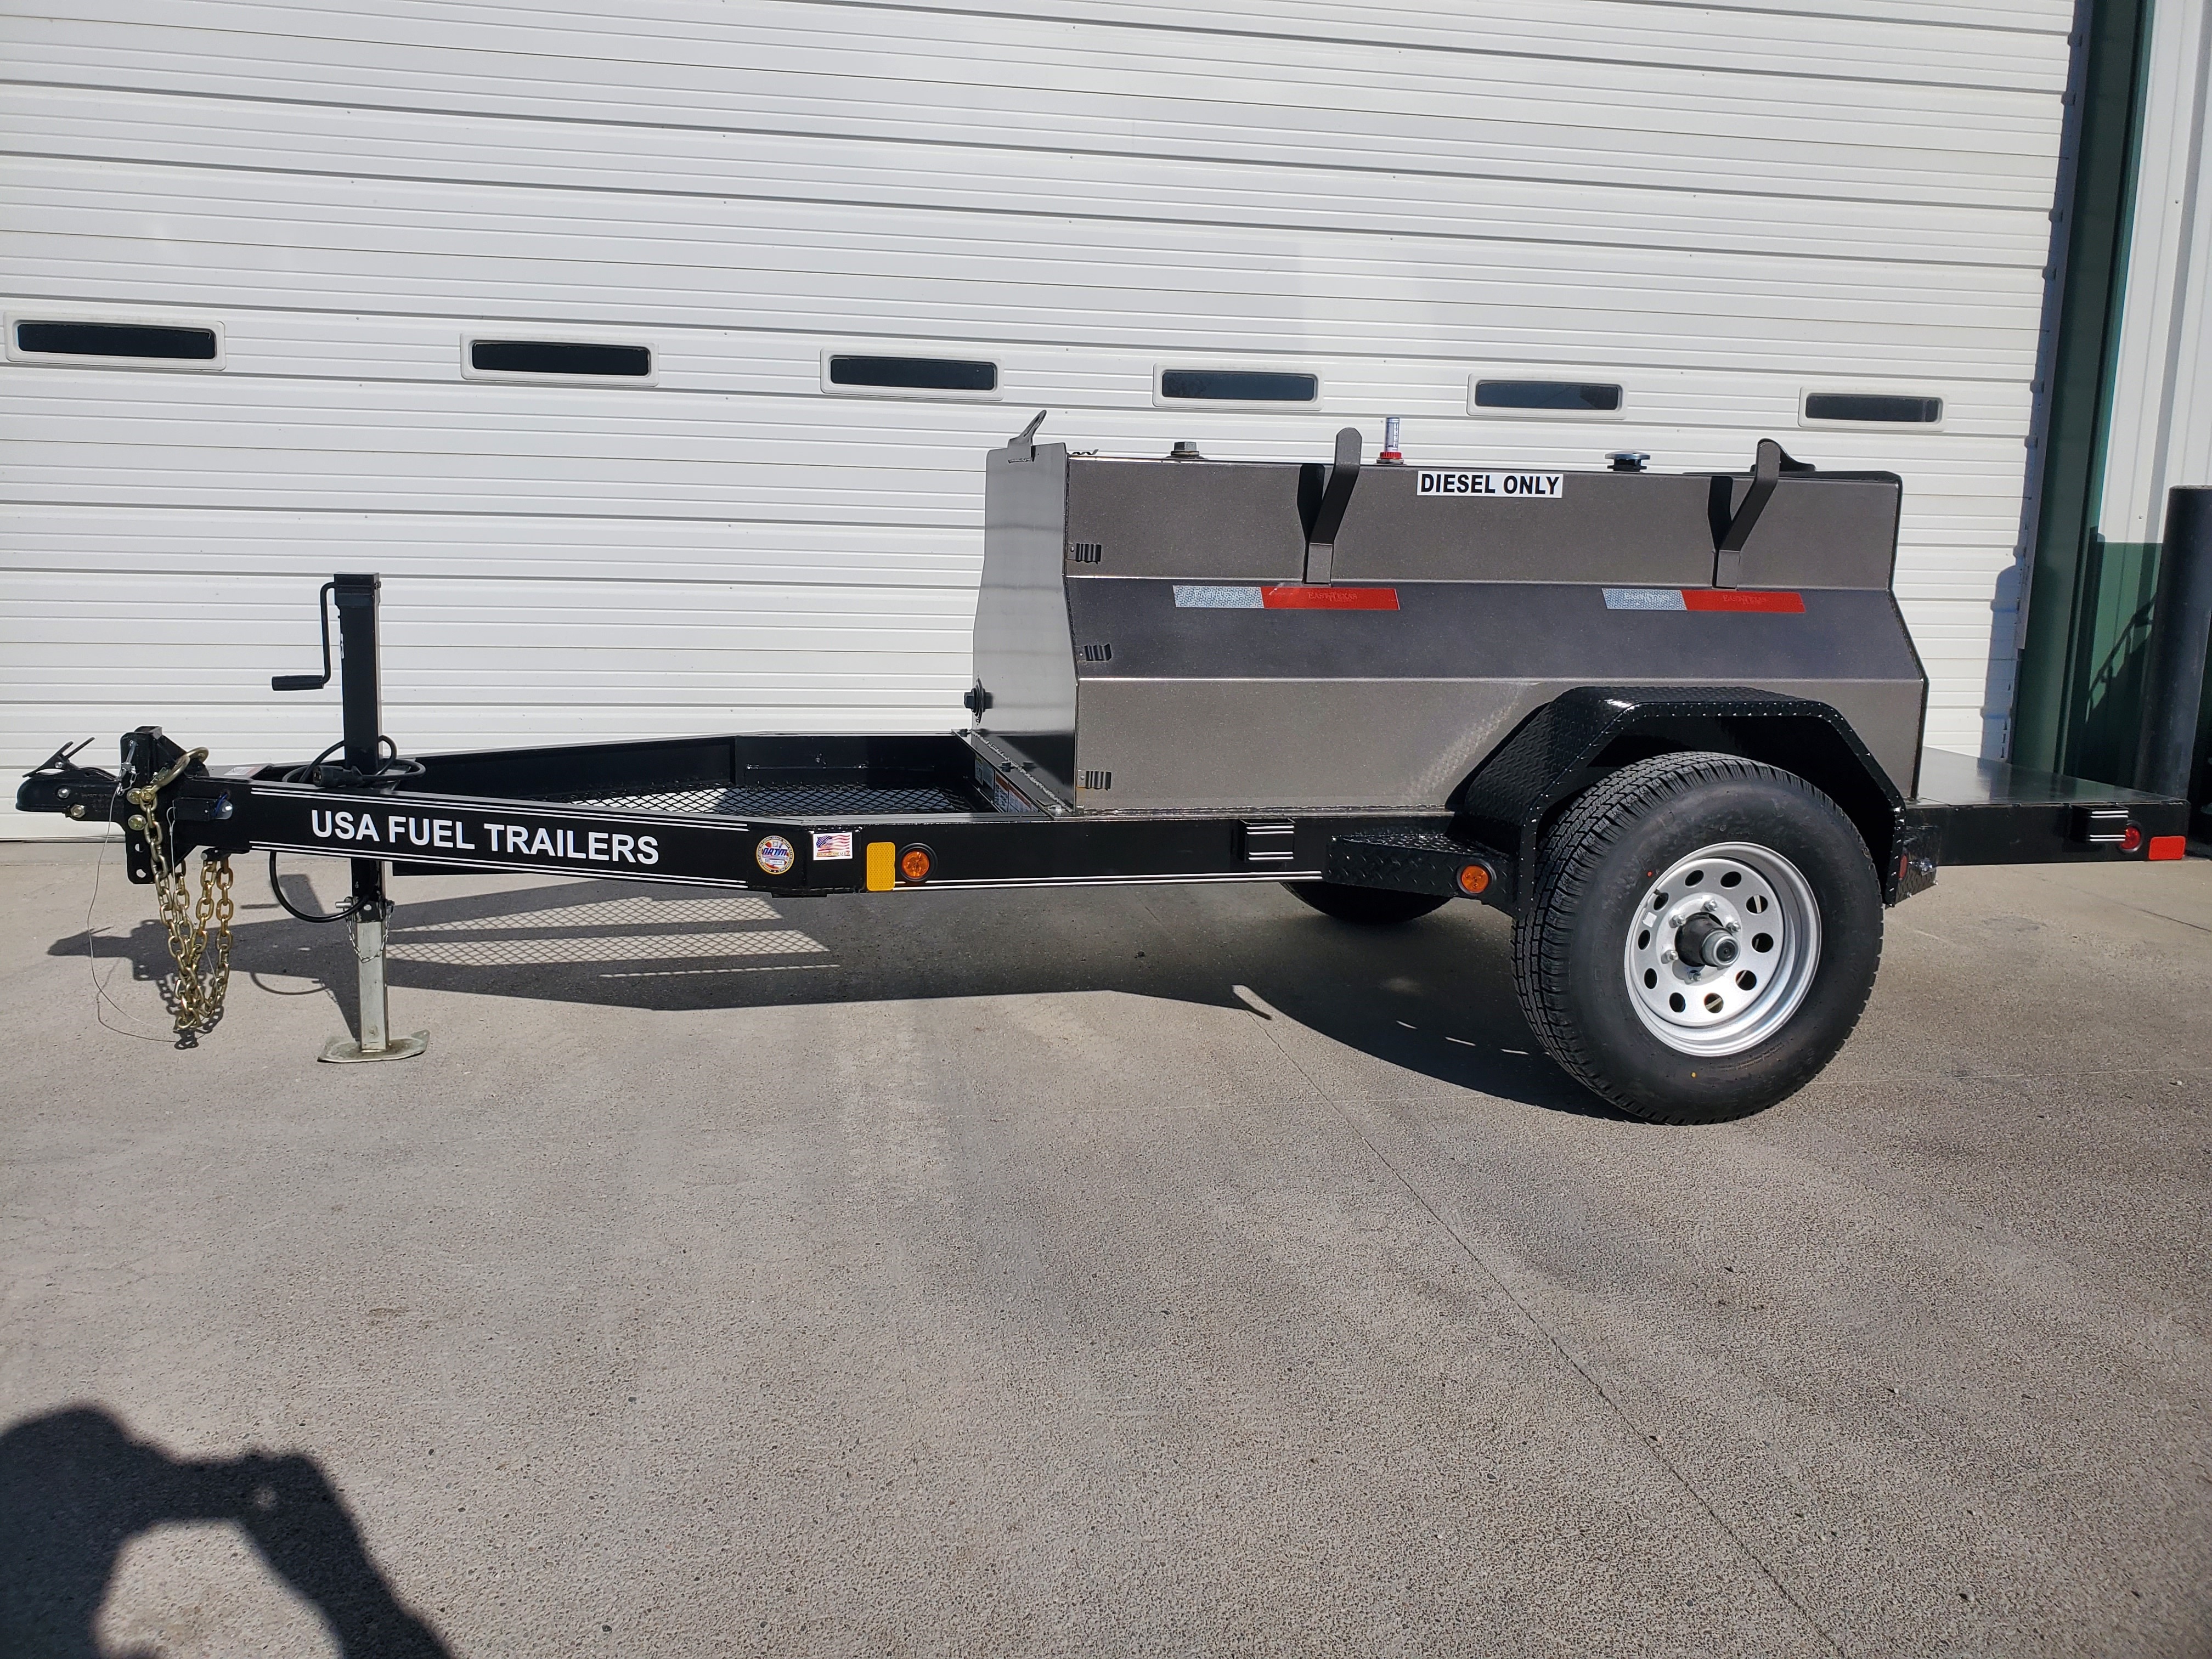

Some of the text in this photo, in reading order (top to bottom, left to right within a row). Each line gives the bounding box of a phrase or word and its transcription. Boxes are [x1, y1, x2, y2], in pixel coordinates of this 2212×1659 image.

[1420, 473, 1560, 495] DIESEL ONLY
[311, 810, 659, 865] USA FUEL TRAILERS
[762, 848, 788, 856] NATM
